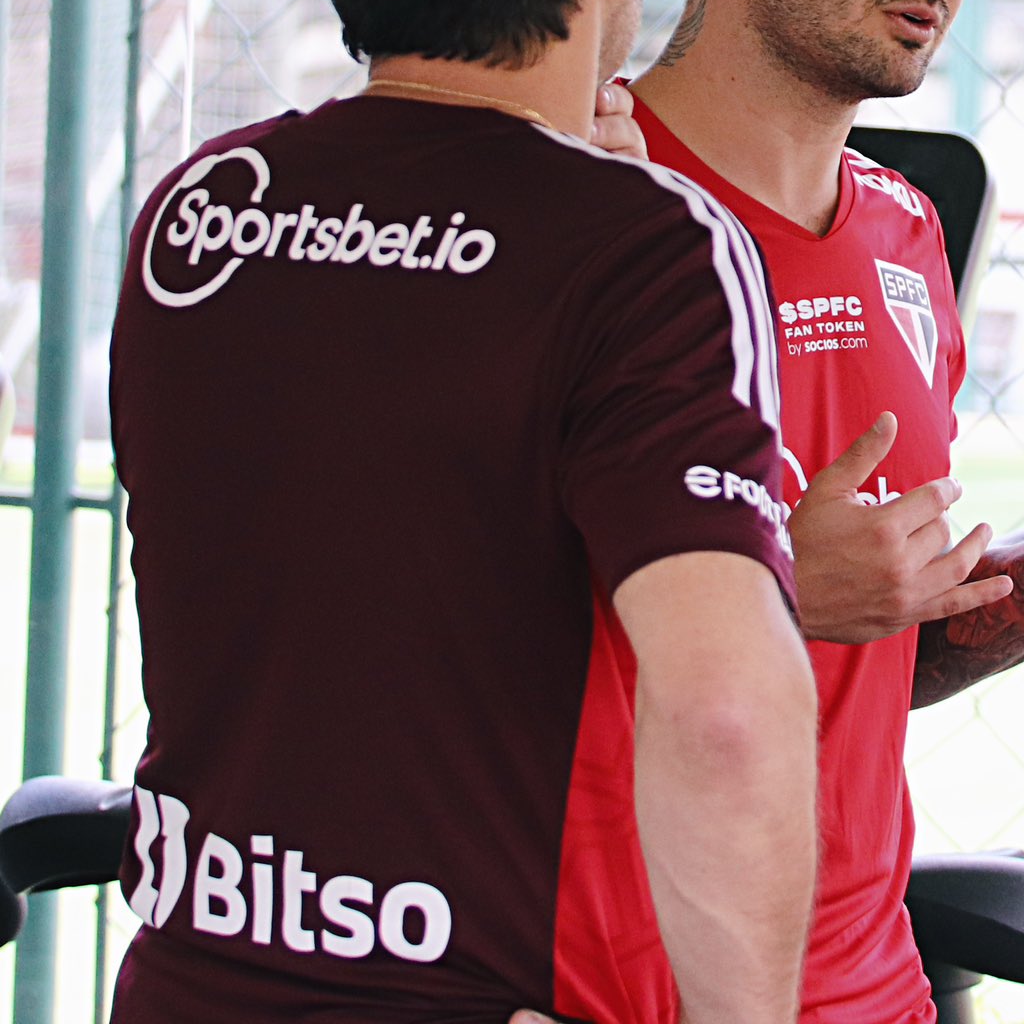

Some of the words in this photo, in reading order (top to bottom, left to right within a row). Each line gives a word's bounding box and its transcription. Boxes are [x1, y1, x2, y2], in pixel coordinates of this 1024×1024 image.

[166, 187, 497, 275] Sportsbet.io
[884, 274, 929, 307] SPFC
[778, 295, 863, 325] $SPFC
[784, 324, 813, 340] FAN
[816, 320, 866, 334] TOKEN
[787, 341, 802, 357] by
[804, 337, 869, 353] SOCIOS.com
[192, 831, 453, 964] Bitso
